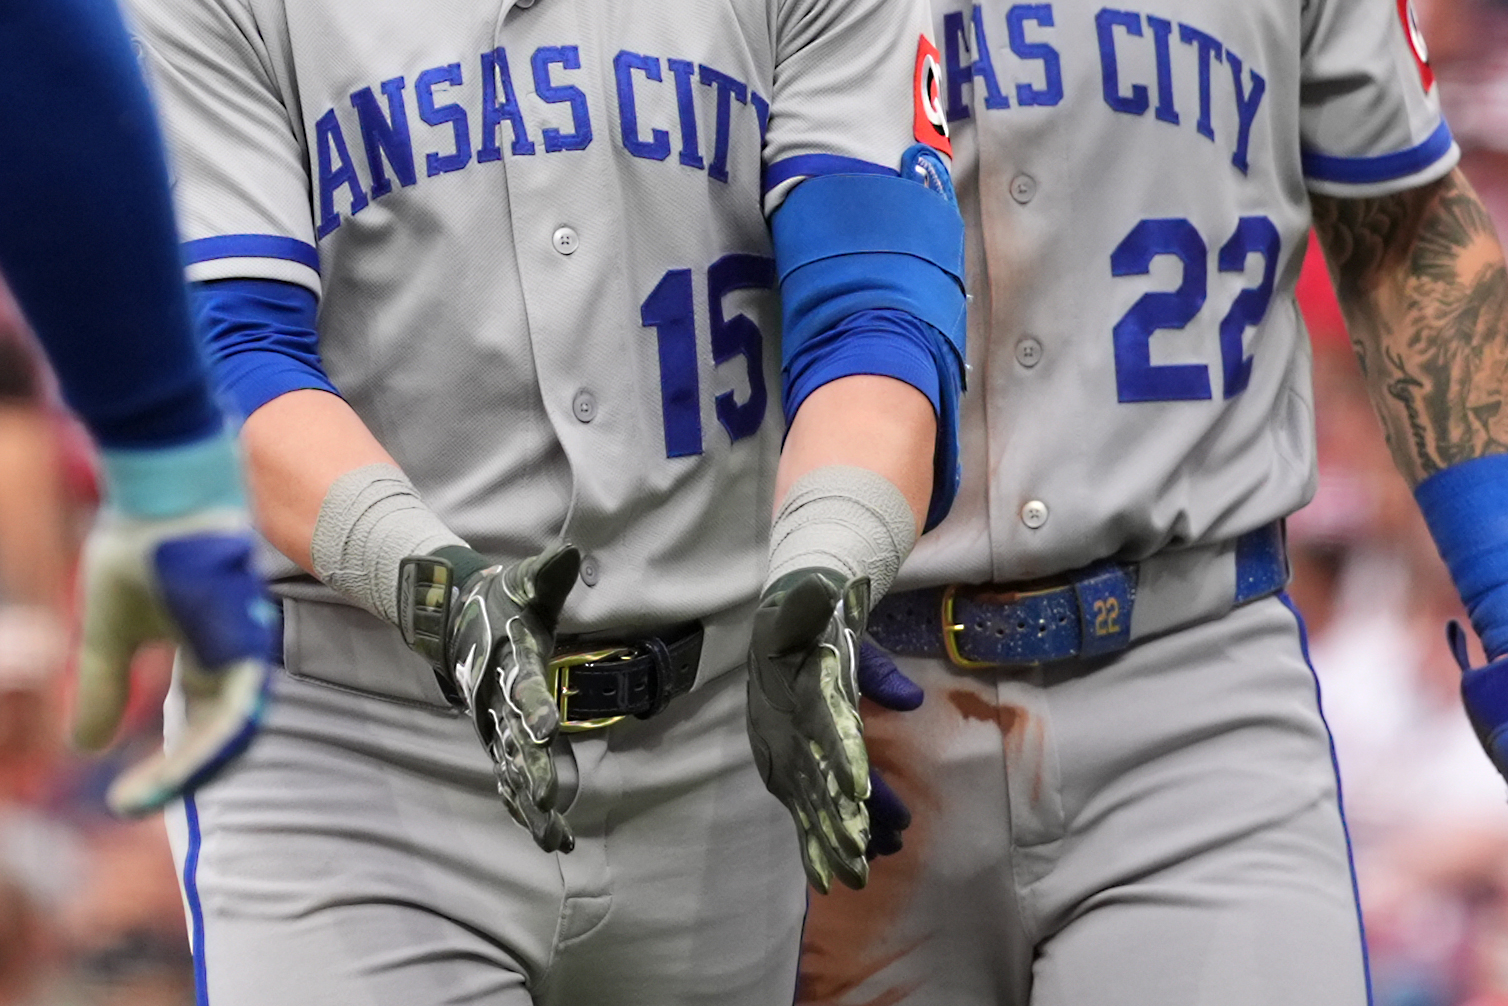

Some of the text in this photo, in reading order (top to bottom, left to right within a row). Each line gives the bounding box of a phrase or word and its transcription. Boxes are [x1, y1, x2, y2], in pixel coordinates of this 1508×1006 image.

[1094, 6, 1267, 178] CITY
[640, 253, 778, 460] 15
[1109, 214, 1282, 404] 22
[1093, 597, 1120, 635] 22
